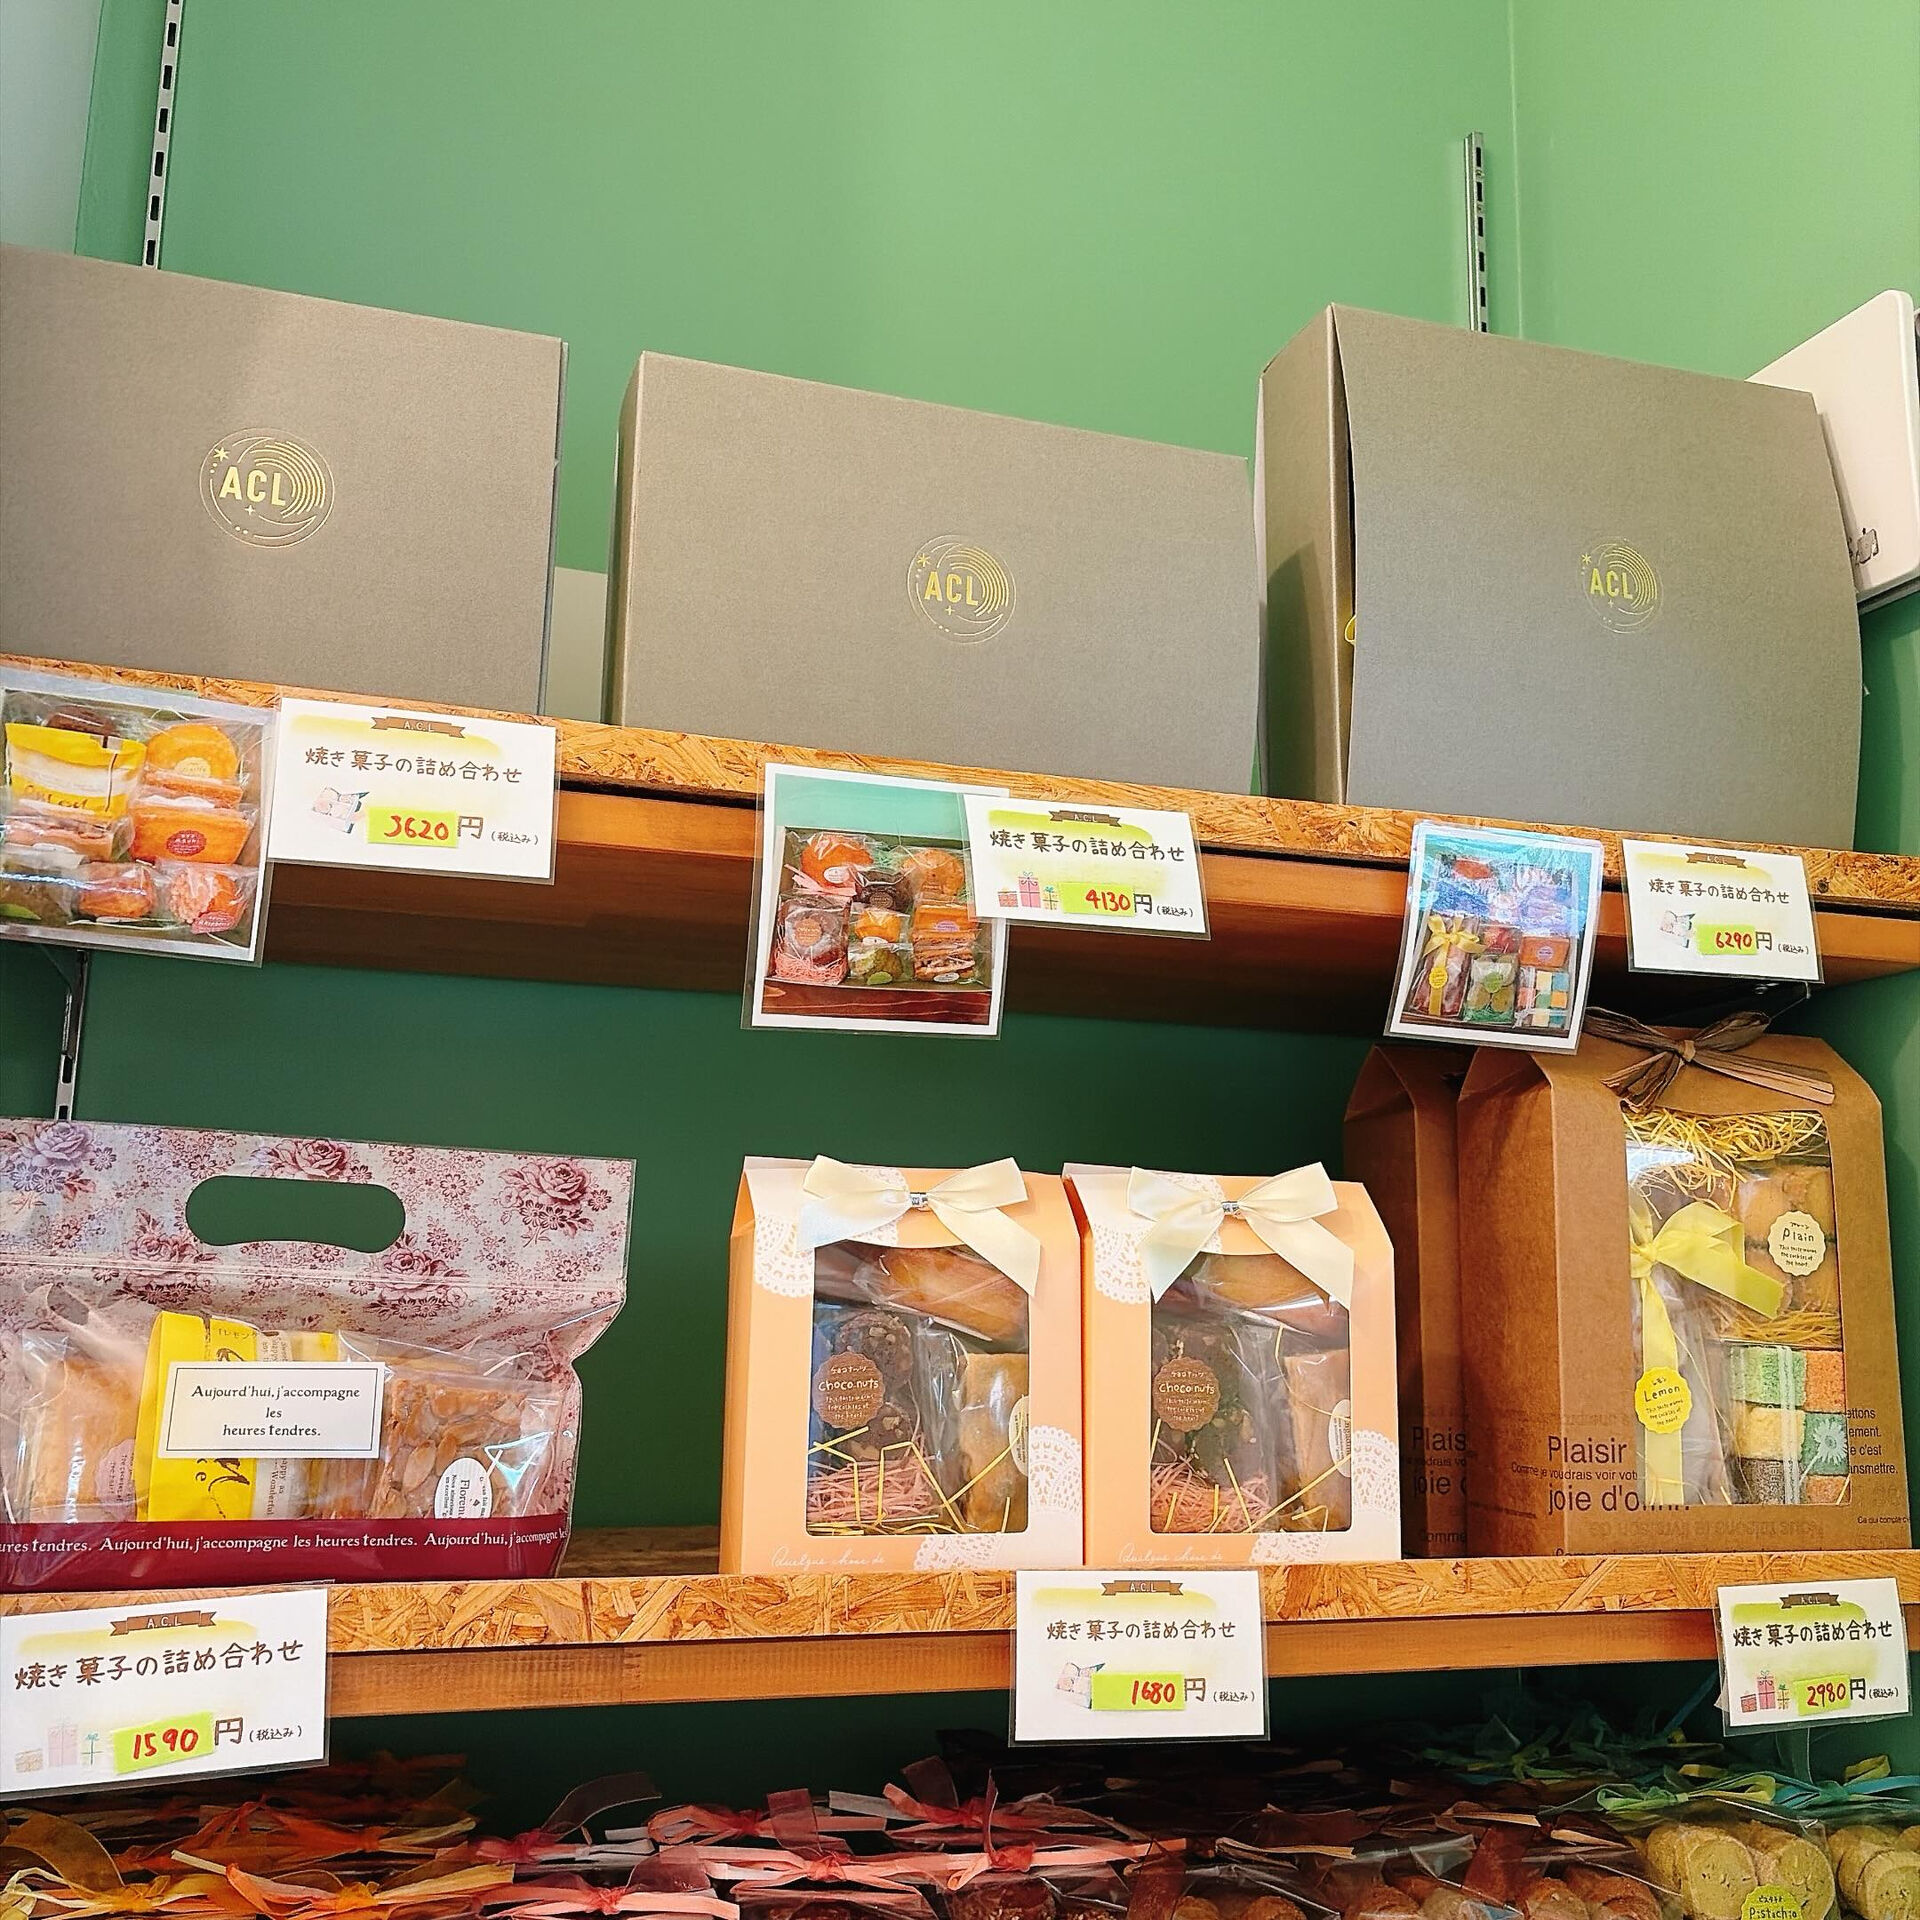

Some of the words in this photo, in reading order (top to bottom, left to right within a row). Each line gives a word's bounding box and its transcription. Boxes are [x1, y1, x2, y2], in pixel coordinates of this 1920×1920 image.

[219, 466, 286, 507] ACL
[924, 571, 979, 606] ACL
[1590, 567, 1634, 600] ACL
[304, 745, 522, 784] 焼き菓子の詰め合わせ
[989, 828, 1185, 863] 焼き菓子の詰め合わせ
[1648, 877, 1790, 904] 焼き菓子の詰め合わせ
[1782, 1227, 1814, 1242] Plain
[1643, 1386, 1680, 1402] Lemon
[265, 1407, 282, 1419] les
[222, 1424, 266, 1436] heures
[268, 1424, 321, 1436] tendres.
[1548, 1436, 1628, 1464] Plaisir
[1860, 1444, 1882, 1456] c'est
[278, 1458, 288, 1481] appy
[1549, 1469, 1592, 1480] voudrais
[1595, 1469, 1616, 1480] voir
[1548, 1484, 1591, 1515] joie
[32, 1538, 92, 1552] tendres.
[293, 1534, 311, 1548] les
[315, 1534, 360, 1548] heures
[363, 1533, 418, 1547] tendres.
[1130, 1582, 1157, 1593] A.C.L
[146, 1615, 182, 1629] A.C.L
[1046, 1618, 1236, 1642] 焼き菓子の詰め合わせ
[1732, 1619, 1893, 1647] 焼き菓子の詰め合わせ
[14, 1639, 304, 1691] 焼き菓子の詰め合わせ
[1749, 1906, 1797, 1919] Pistachio
